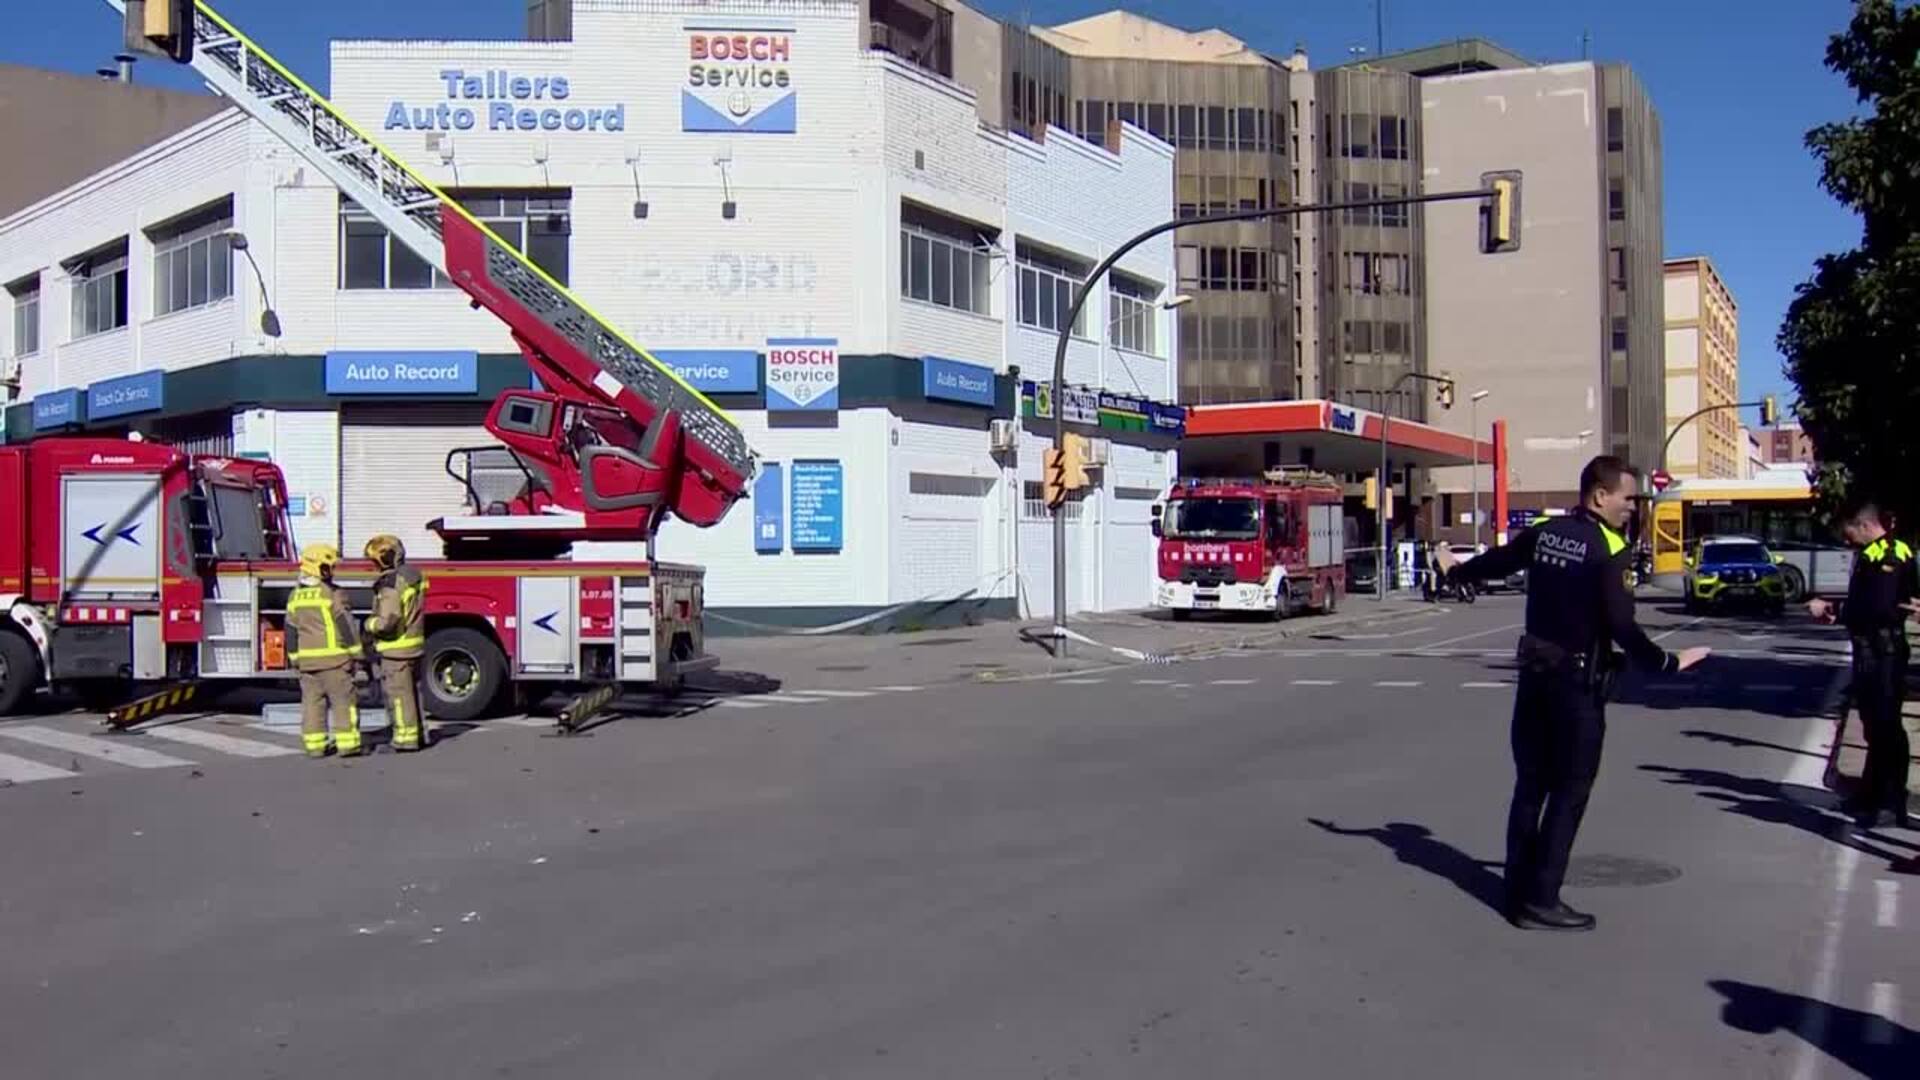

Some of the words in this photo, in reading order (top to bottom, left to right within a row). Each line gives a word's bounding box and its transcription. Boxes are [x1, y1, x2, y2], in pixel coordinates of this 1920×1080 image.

[690, 35, 789, 61] BOSCH
[440, 70, 570, 100] Tallers
[689, 64, 790, 88] Service
[384, 101, 475, 131] Auto
[489, 102, 625, 132] Record
[770, 350, 834, 365] BOSCH
[346, 363, 389, 380] Auto
[395, 363, 459, 380] Record
[666, 362, 729, 378] ervice
[771, 368, 835, 382] Service
[936, 372, 957, 388] Auto
[958, 374, 988, 393] Record
[1183, 542, 1231, 553] bombers
[1536, 531, 1587, 556] POLICIA
